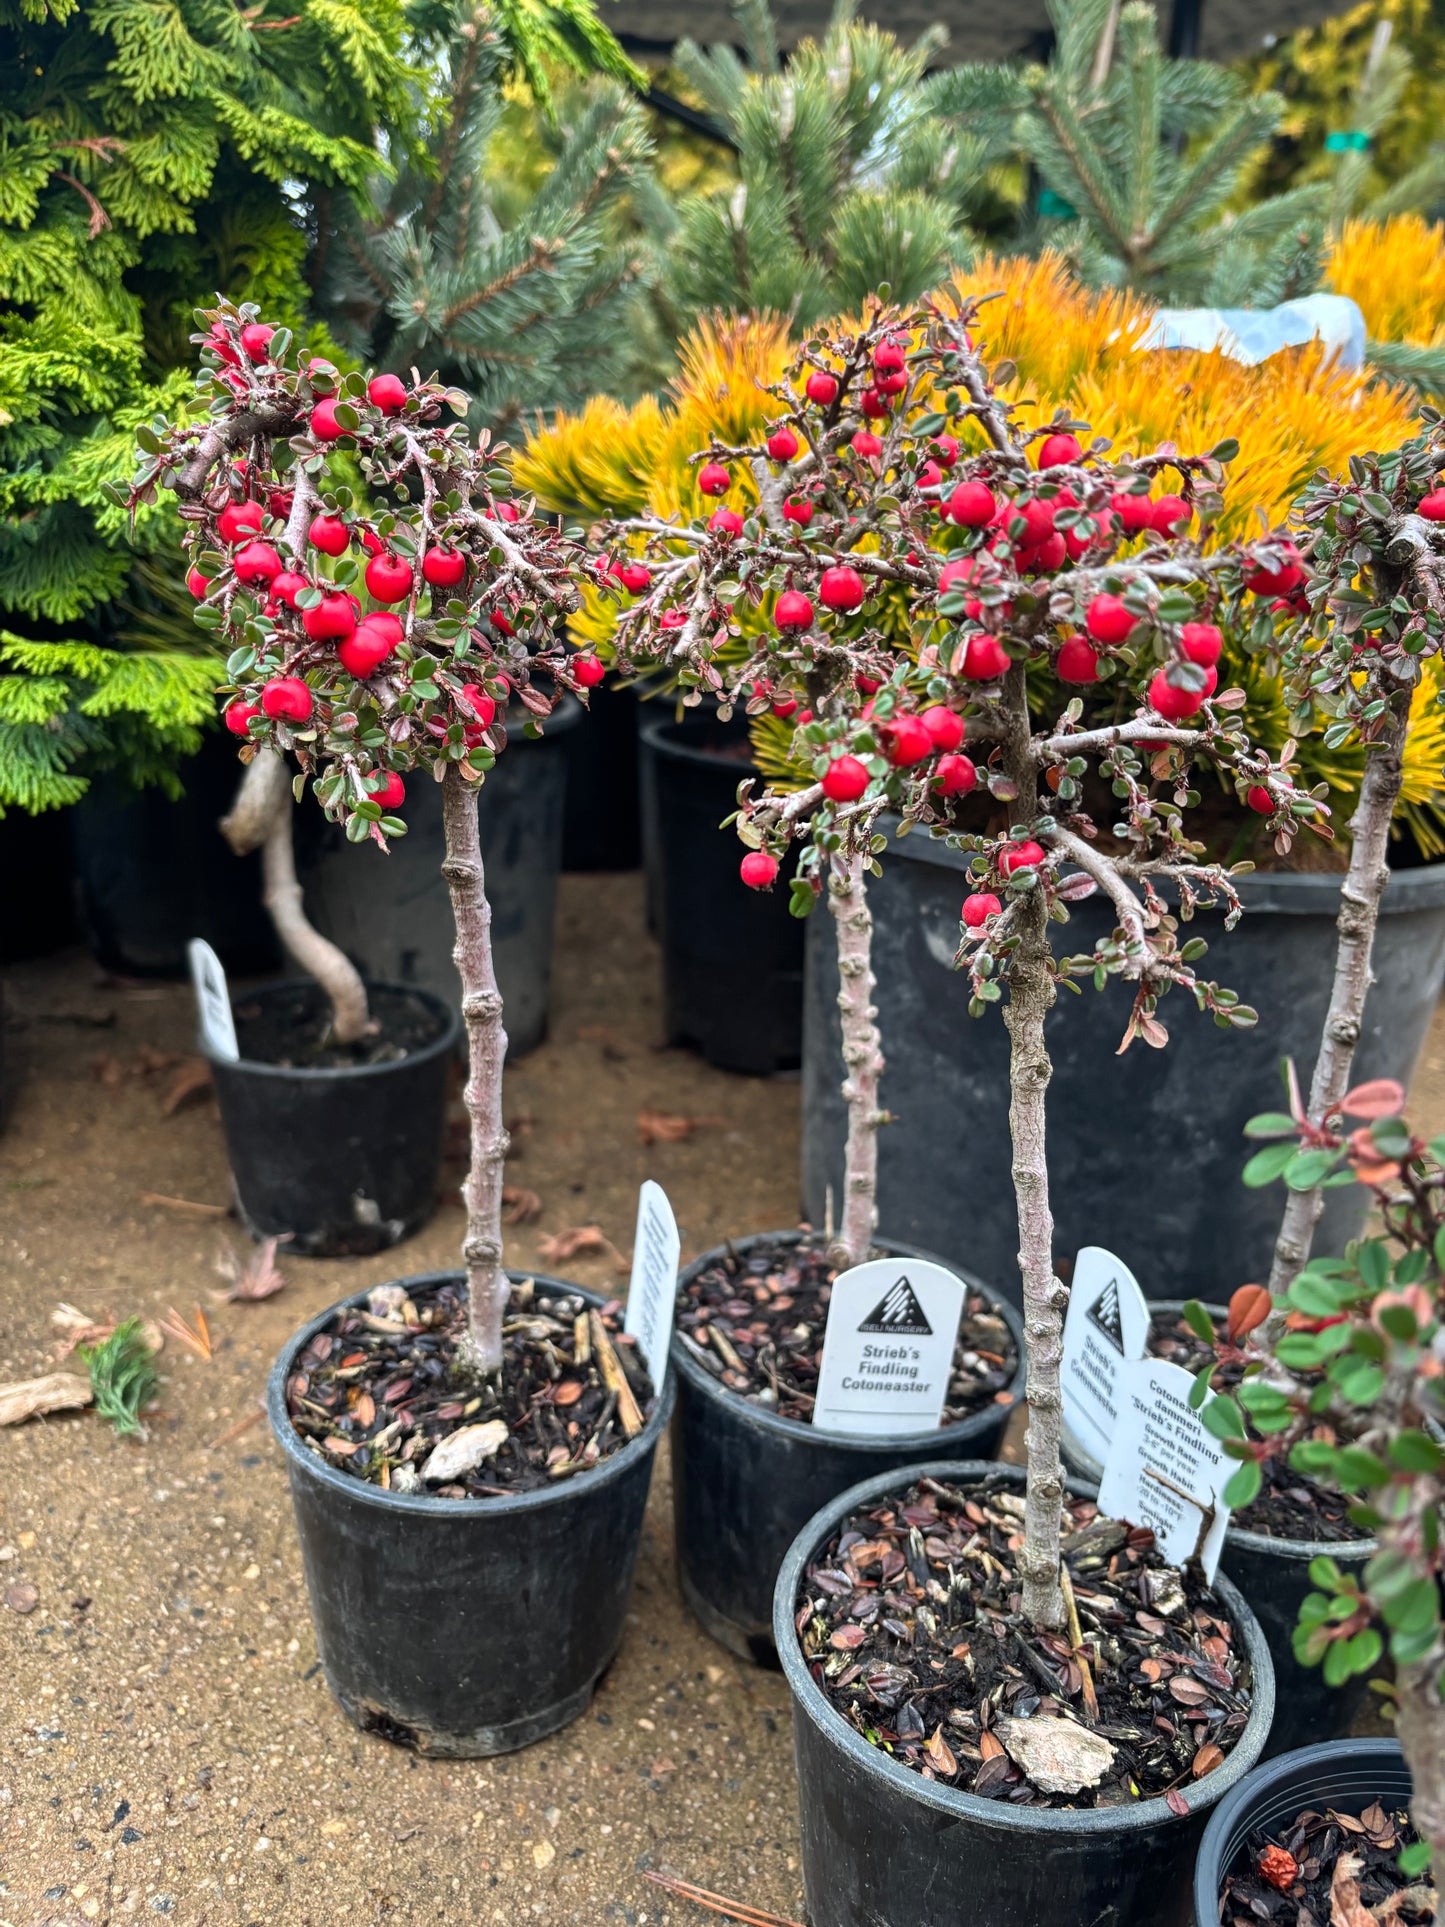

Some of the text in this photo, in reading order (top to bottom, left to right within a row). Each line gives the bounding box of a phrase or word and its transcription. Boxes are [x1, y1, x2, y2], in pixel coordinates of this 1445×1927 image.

[858, 1361, 919, 1378] Findling
[862, 1345, 920, 1360] Strieb's
[841, 1377, 932, 1393] Cotoneaster
[1070, 1358, 1118, 1420] Cotoneaster
[1080, 1351, 1114, 1397] Findling
[1149, 1379, 1204, 1423] Cotoneast
[1154, 1400, 1202, 1436] dammeri
[1145, 1423, 1200, 1468] Growth Rate:
[1160, 1447, 1175, 1462] per
[1176, 1459, 1197, 1476] year
[1138, 1445, 1169, 1474] Growth
[1170, 1468, 1197, 1493] Habit:
